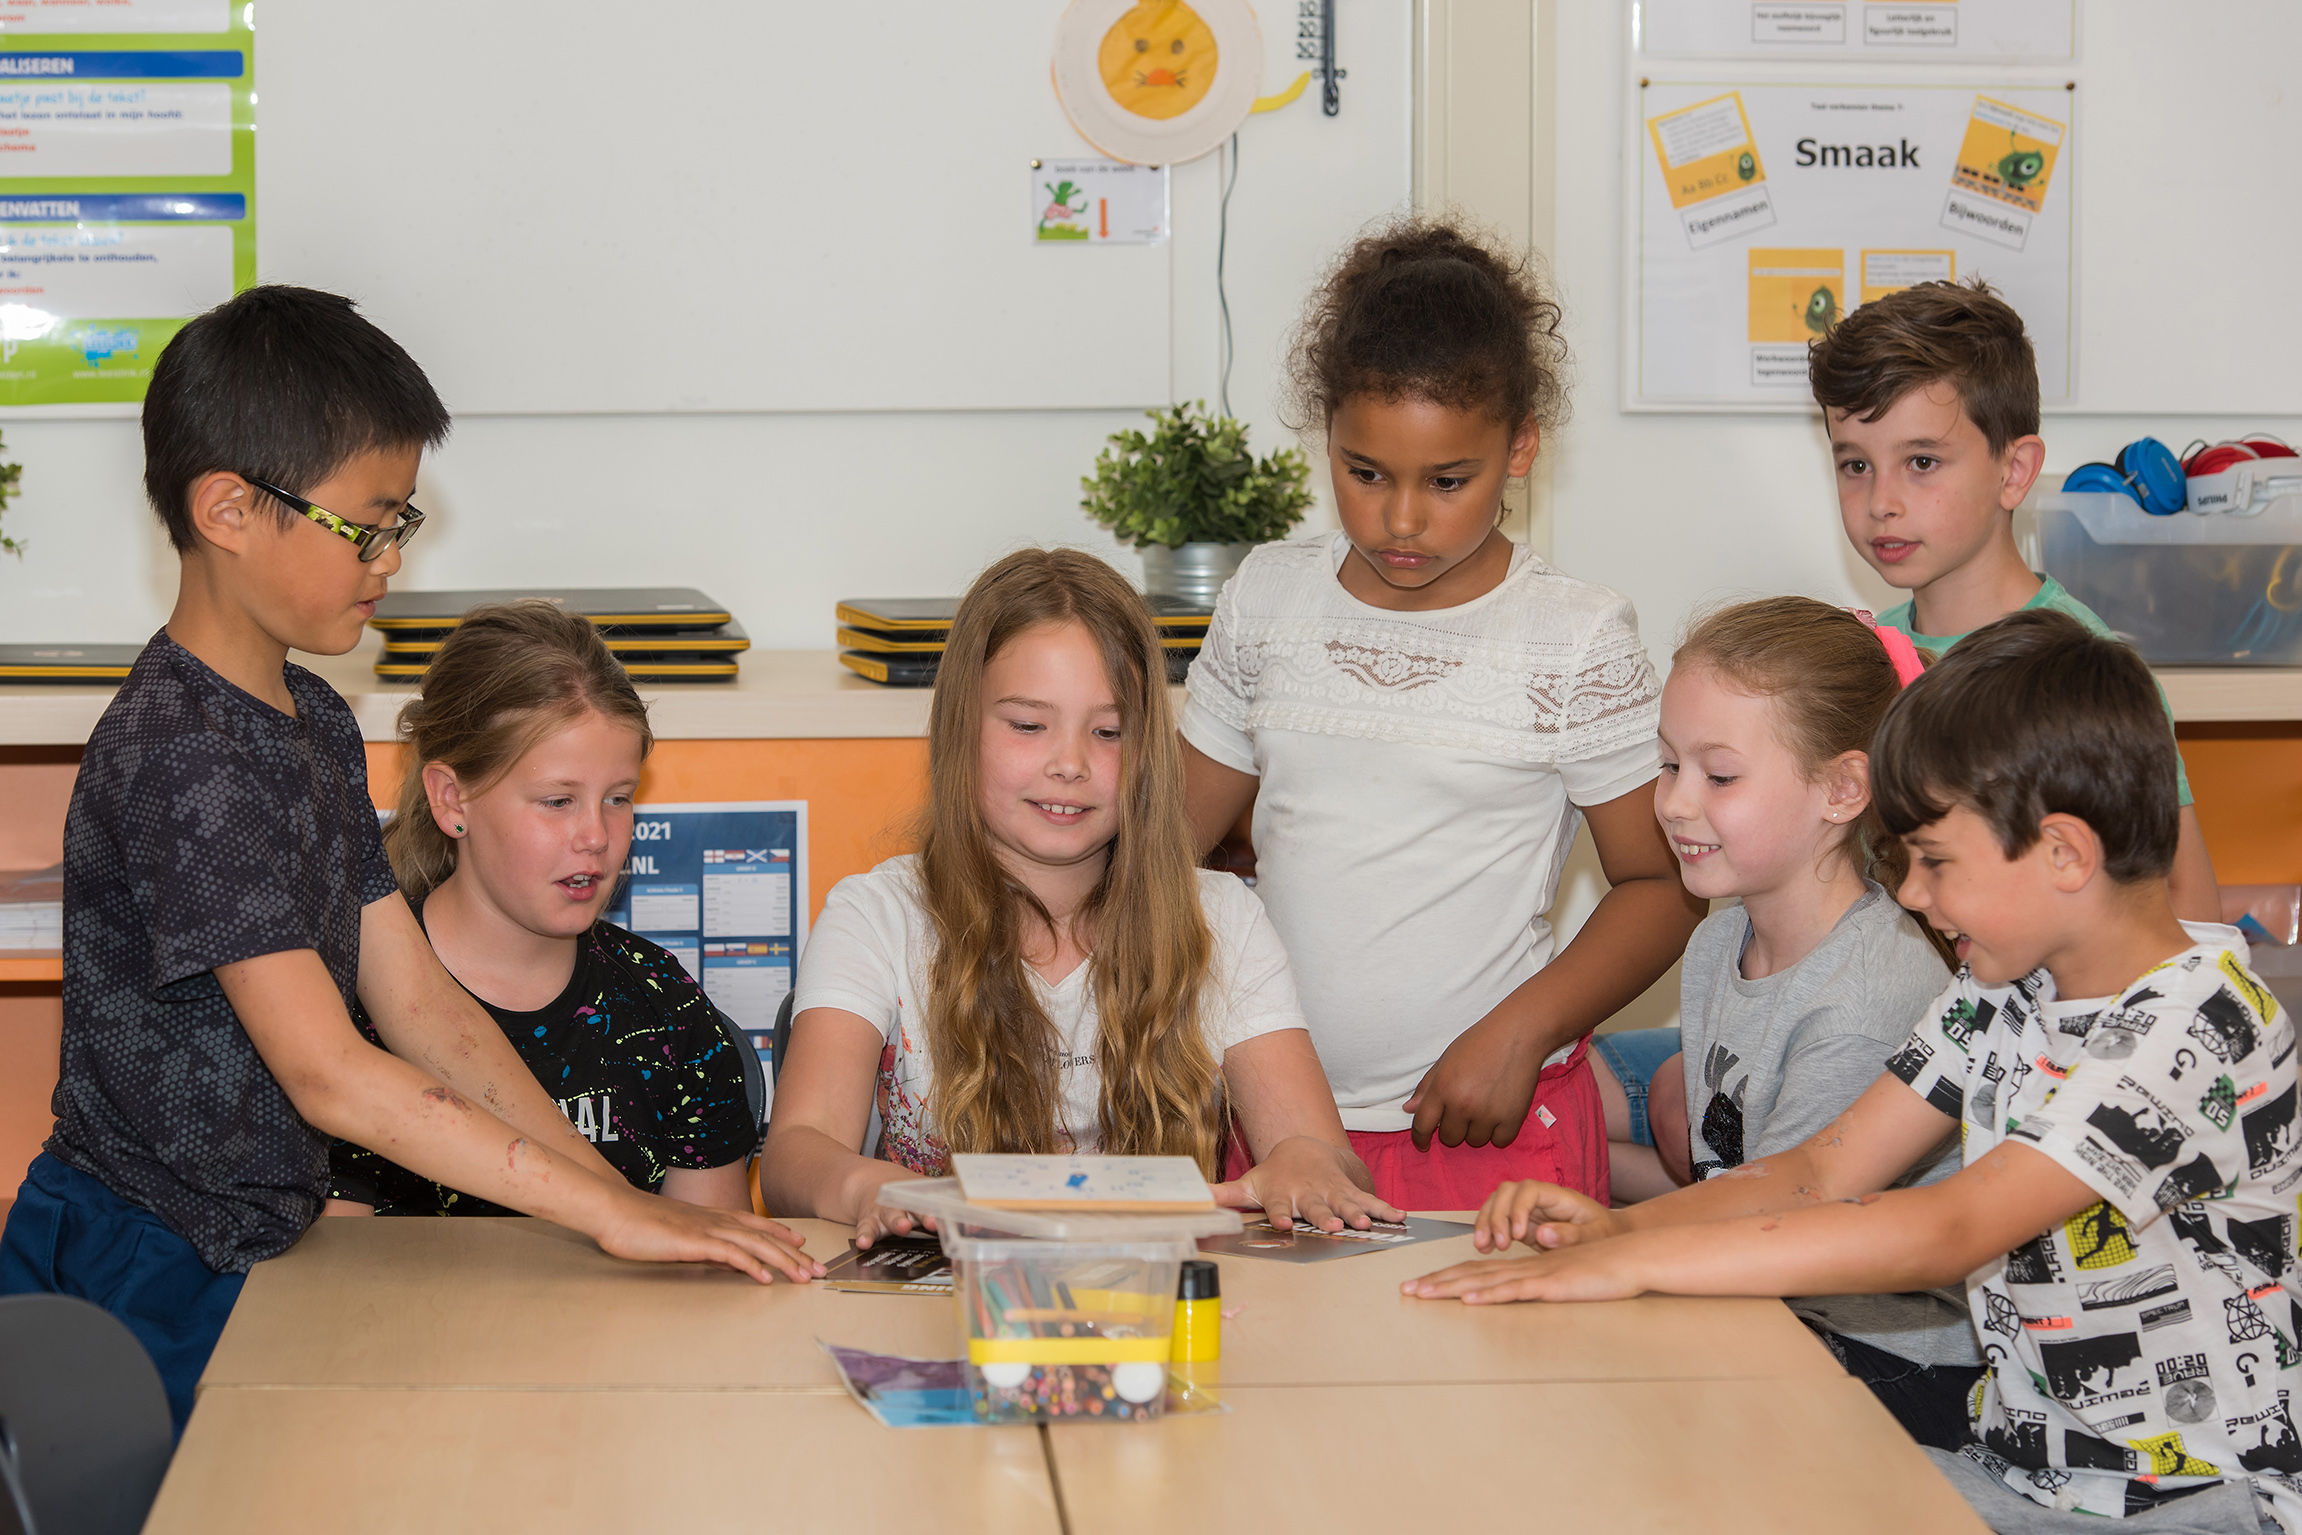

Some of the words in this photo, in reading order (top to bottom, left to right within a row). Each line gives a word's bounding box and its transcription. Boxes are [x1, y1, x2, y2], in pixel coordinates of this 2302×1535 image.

[1796, 138, 1920, 168] Smaak
[1688, 200, 1769, 235] Eigennamen
[1948, 200, 2025, 238] Bijwoorden
[631, 821, 672, 841] 021
[2140, 1301, 2186, 1319] SPECTRUM
[2161, 1366, 2210, 1386] RAVE
